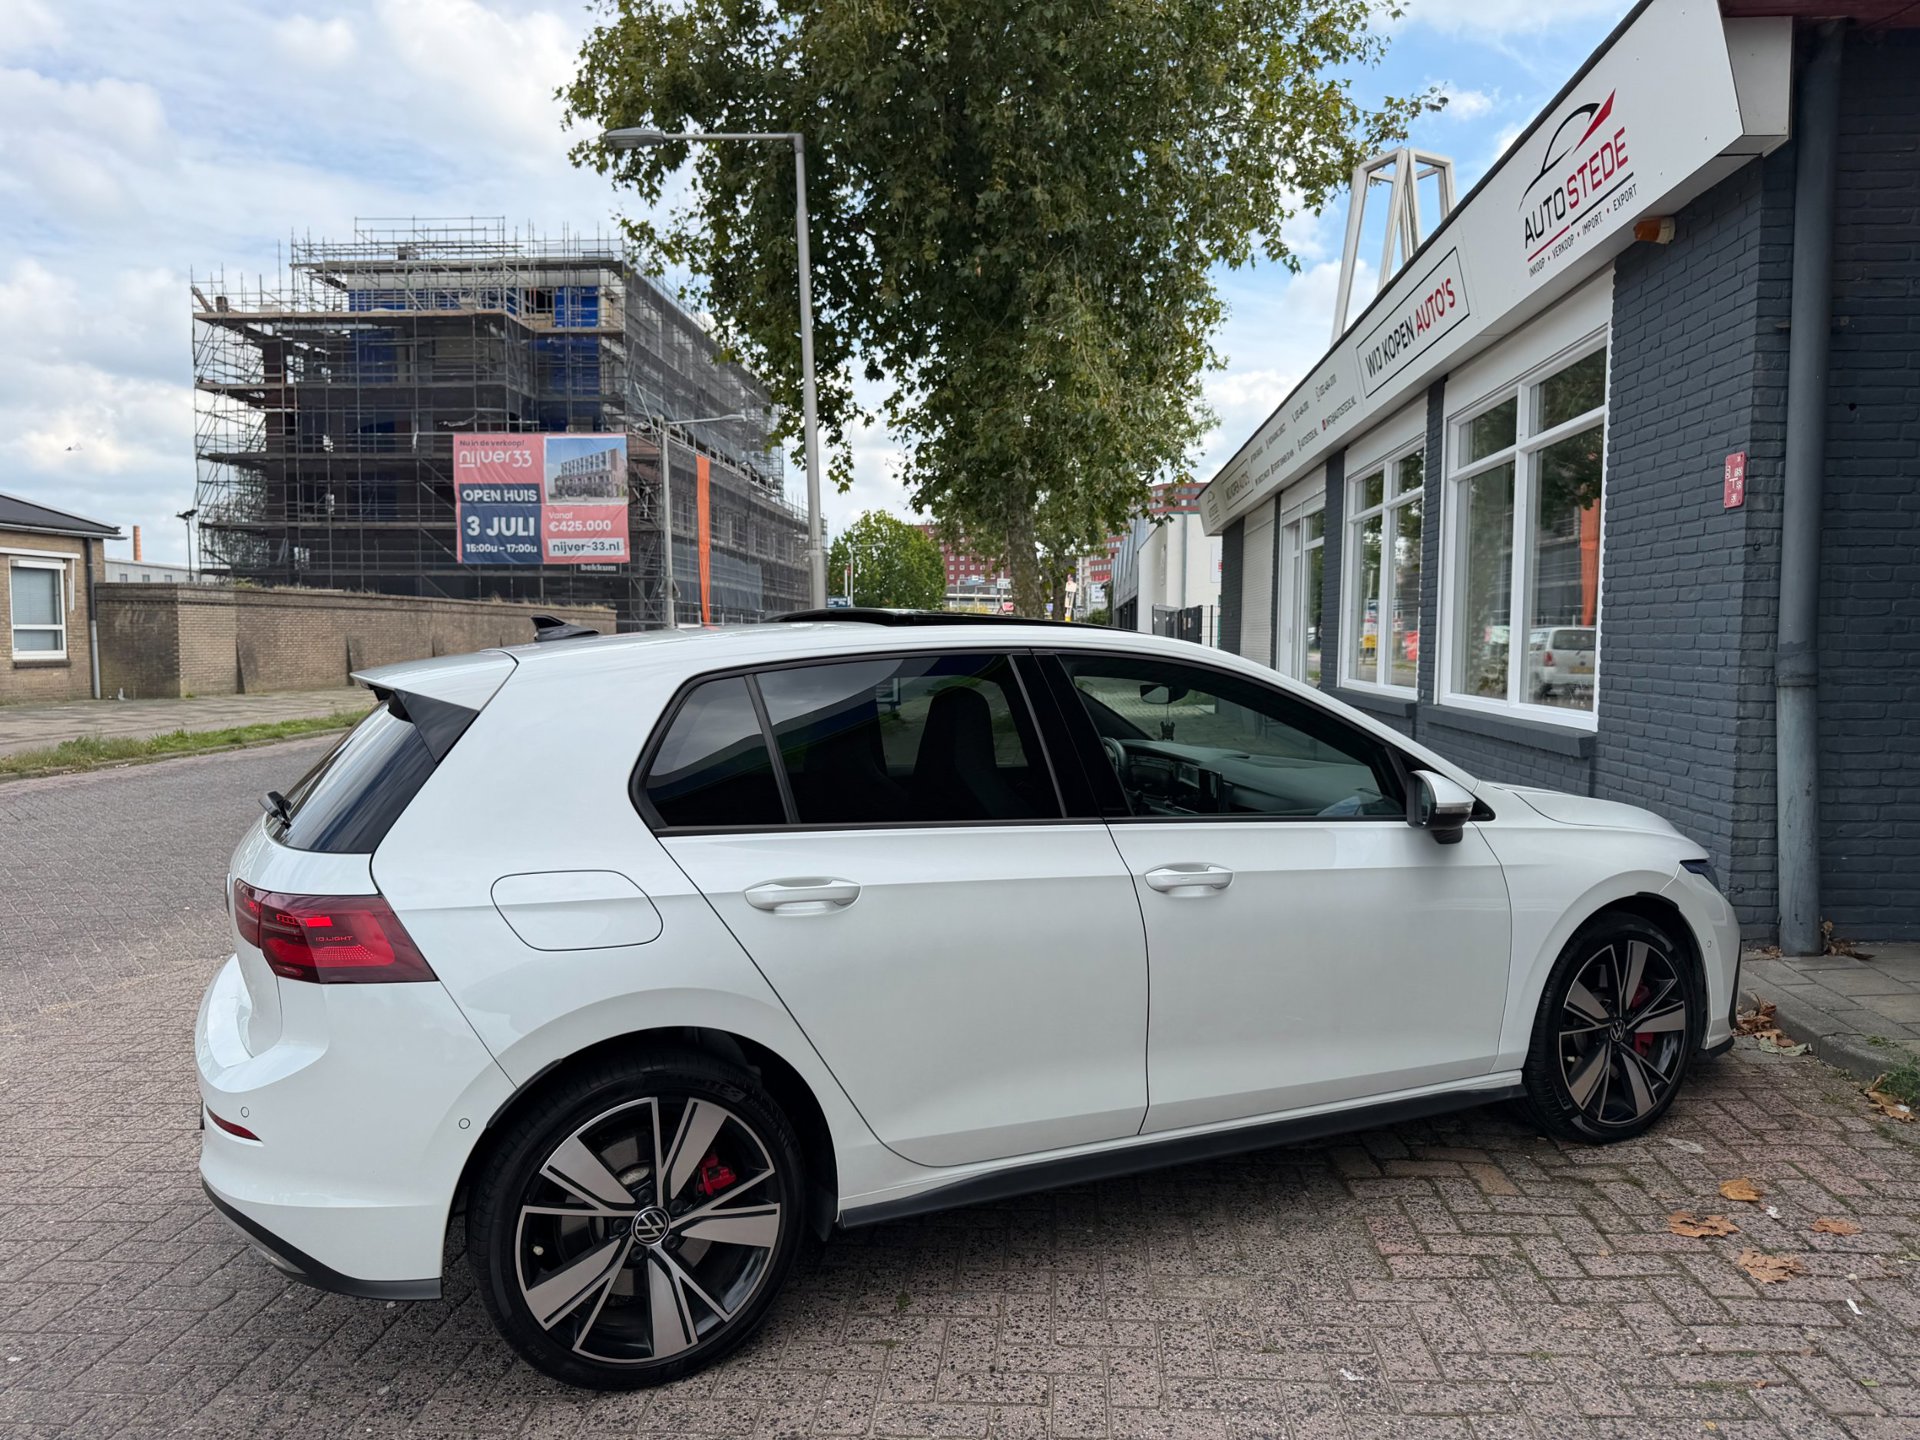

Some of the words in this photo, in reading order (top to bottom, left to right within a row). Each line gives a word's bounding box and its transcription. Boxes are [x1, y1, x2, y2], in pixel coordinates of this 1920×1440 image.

[1525, 126, 1629, 249] AUTOSTEDE
[1551, 234, 1575, 260] VERKOOP
[1581, 211, 1603, 236] IMPORT
[1612, 183, 1638, 212] EXPORT
[1365, 346, 1383, 378] WIJ
[1382, 316, 1416, 366] KOPEN
[1415, 277, 1456, 337] AUTO'S
[490, 440, 525, 448] verkoop!
[462, 489, 501, 502] OPEN
[503, 489, 538, 502] HUIS
[466, 515, 481, 537] 3
[486, 516, 535, 537] JULI
[548, 520, 612, 532] €425.000
[506, 543, 538, 553] 17:00u
[553, 541, 620, 554] nijver-33.nl
